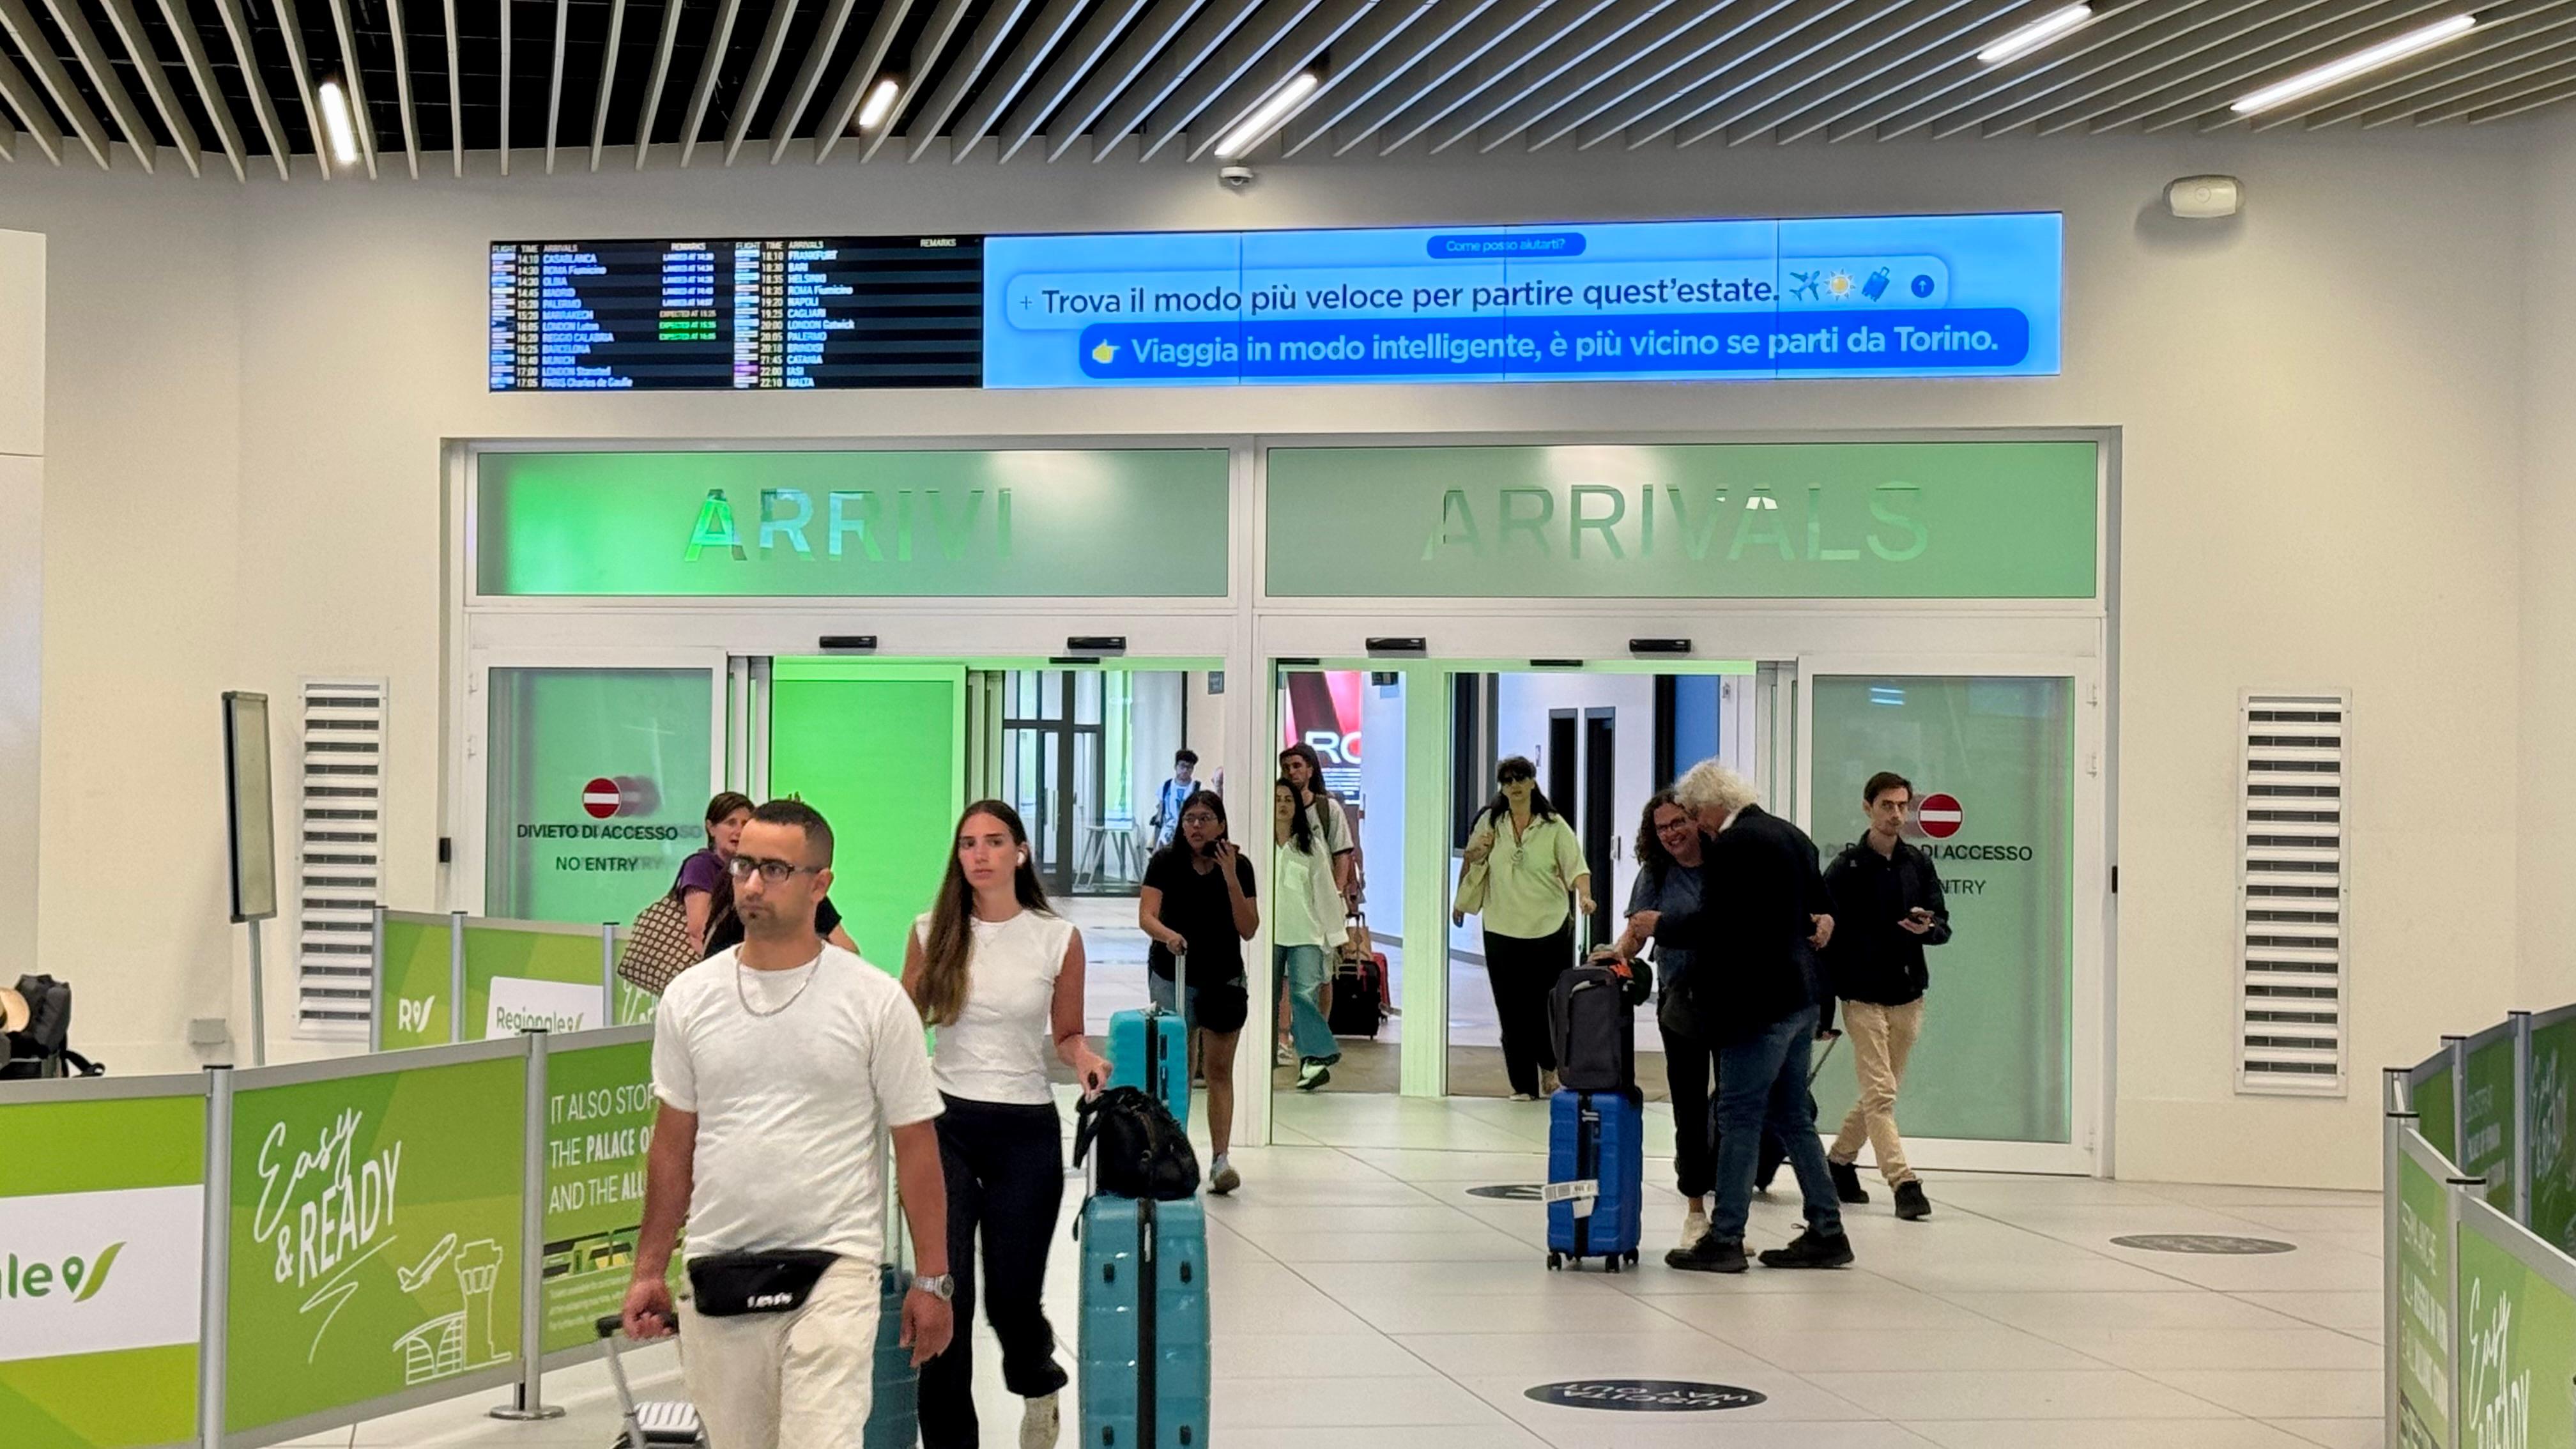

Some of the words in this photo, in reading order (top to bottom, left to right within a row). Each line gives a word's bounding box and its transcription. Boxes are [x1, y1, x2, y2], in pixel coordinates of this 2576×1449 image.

[521, 244, 539, 252] TIME
[543, 244, 578, 252] ARRIVALS
[671, 242, 706, 251] REMARKS
[921, 239, 956, 247] REMARKS
[1446, 240, 1481, 252] Come
[1483, 240, 1518, 252] posso
[1520, 238, 1566, 250] aiutarti?
[1042, 289, 1121, 314] Trova
[1130, 288, 1143, 312] il
[1154, 287, 1241, 312] modo
[1251, 284, 1296, 315] più
[1307, 284, 1402, 310] veloce
[1413, 287, 1464, 313] per
[1472, 280, 1574, 311] partire
[1132, 337, 1238, 366] Viaggia
[1247, 335, 1271, 361] in
[1279, 334, 1365, 360] modo
[1373, 334, 1542, 363] intelligente,
[1551, 330, 1568, 356] è
[1576, 329, 1621, 361] più
[1630, 329, 1719, 356] vicino
[1727, 333, 1759, 354] se
[1768, 326, 1838, 359] parti
[1848, 326, 1885, 352] da
[1894, 325, 1998, 351] Torino.
[684, 488, 1012, 562] ARRIVI
[1421, 482, 1929, 562] ARRIVALS
[518, 825, 578, 839] DIVIETO
[582, 825, 597, 839] DI
[601, 825, 678, 840] ACCESSO
[556, 857, 580, 871] NO
[585, 857, 639, 871] ENTRY
[1943, 845, 2032, 861] ACCESSO
[1941, 879, 1986, 894] NTRY
[496, 1006, 566, 1036] Regionale
[551, 1095, 565, 1124] IT
[567, 1088, 611, 1121] ALSO
[550, 1137, 581, 1169] THE
[586, 1128, 635, 1163] PALACE
[254, 1107, 363, 1243] Easy
[549, 1181, 585, 1215] AND
[588, 1175, 618, 1204] THE
